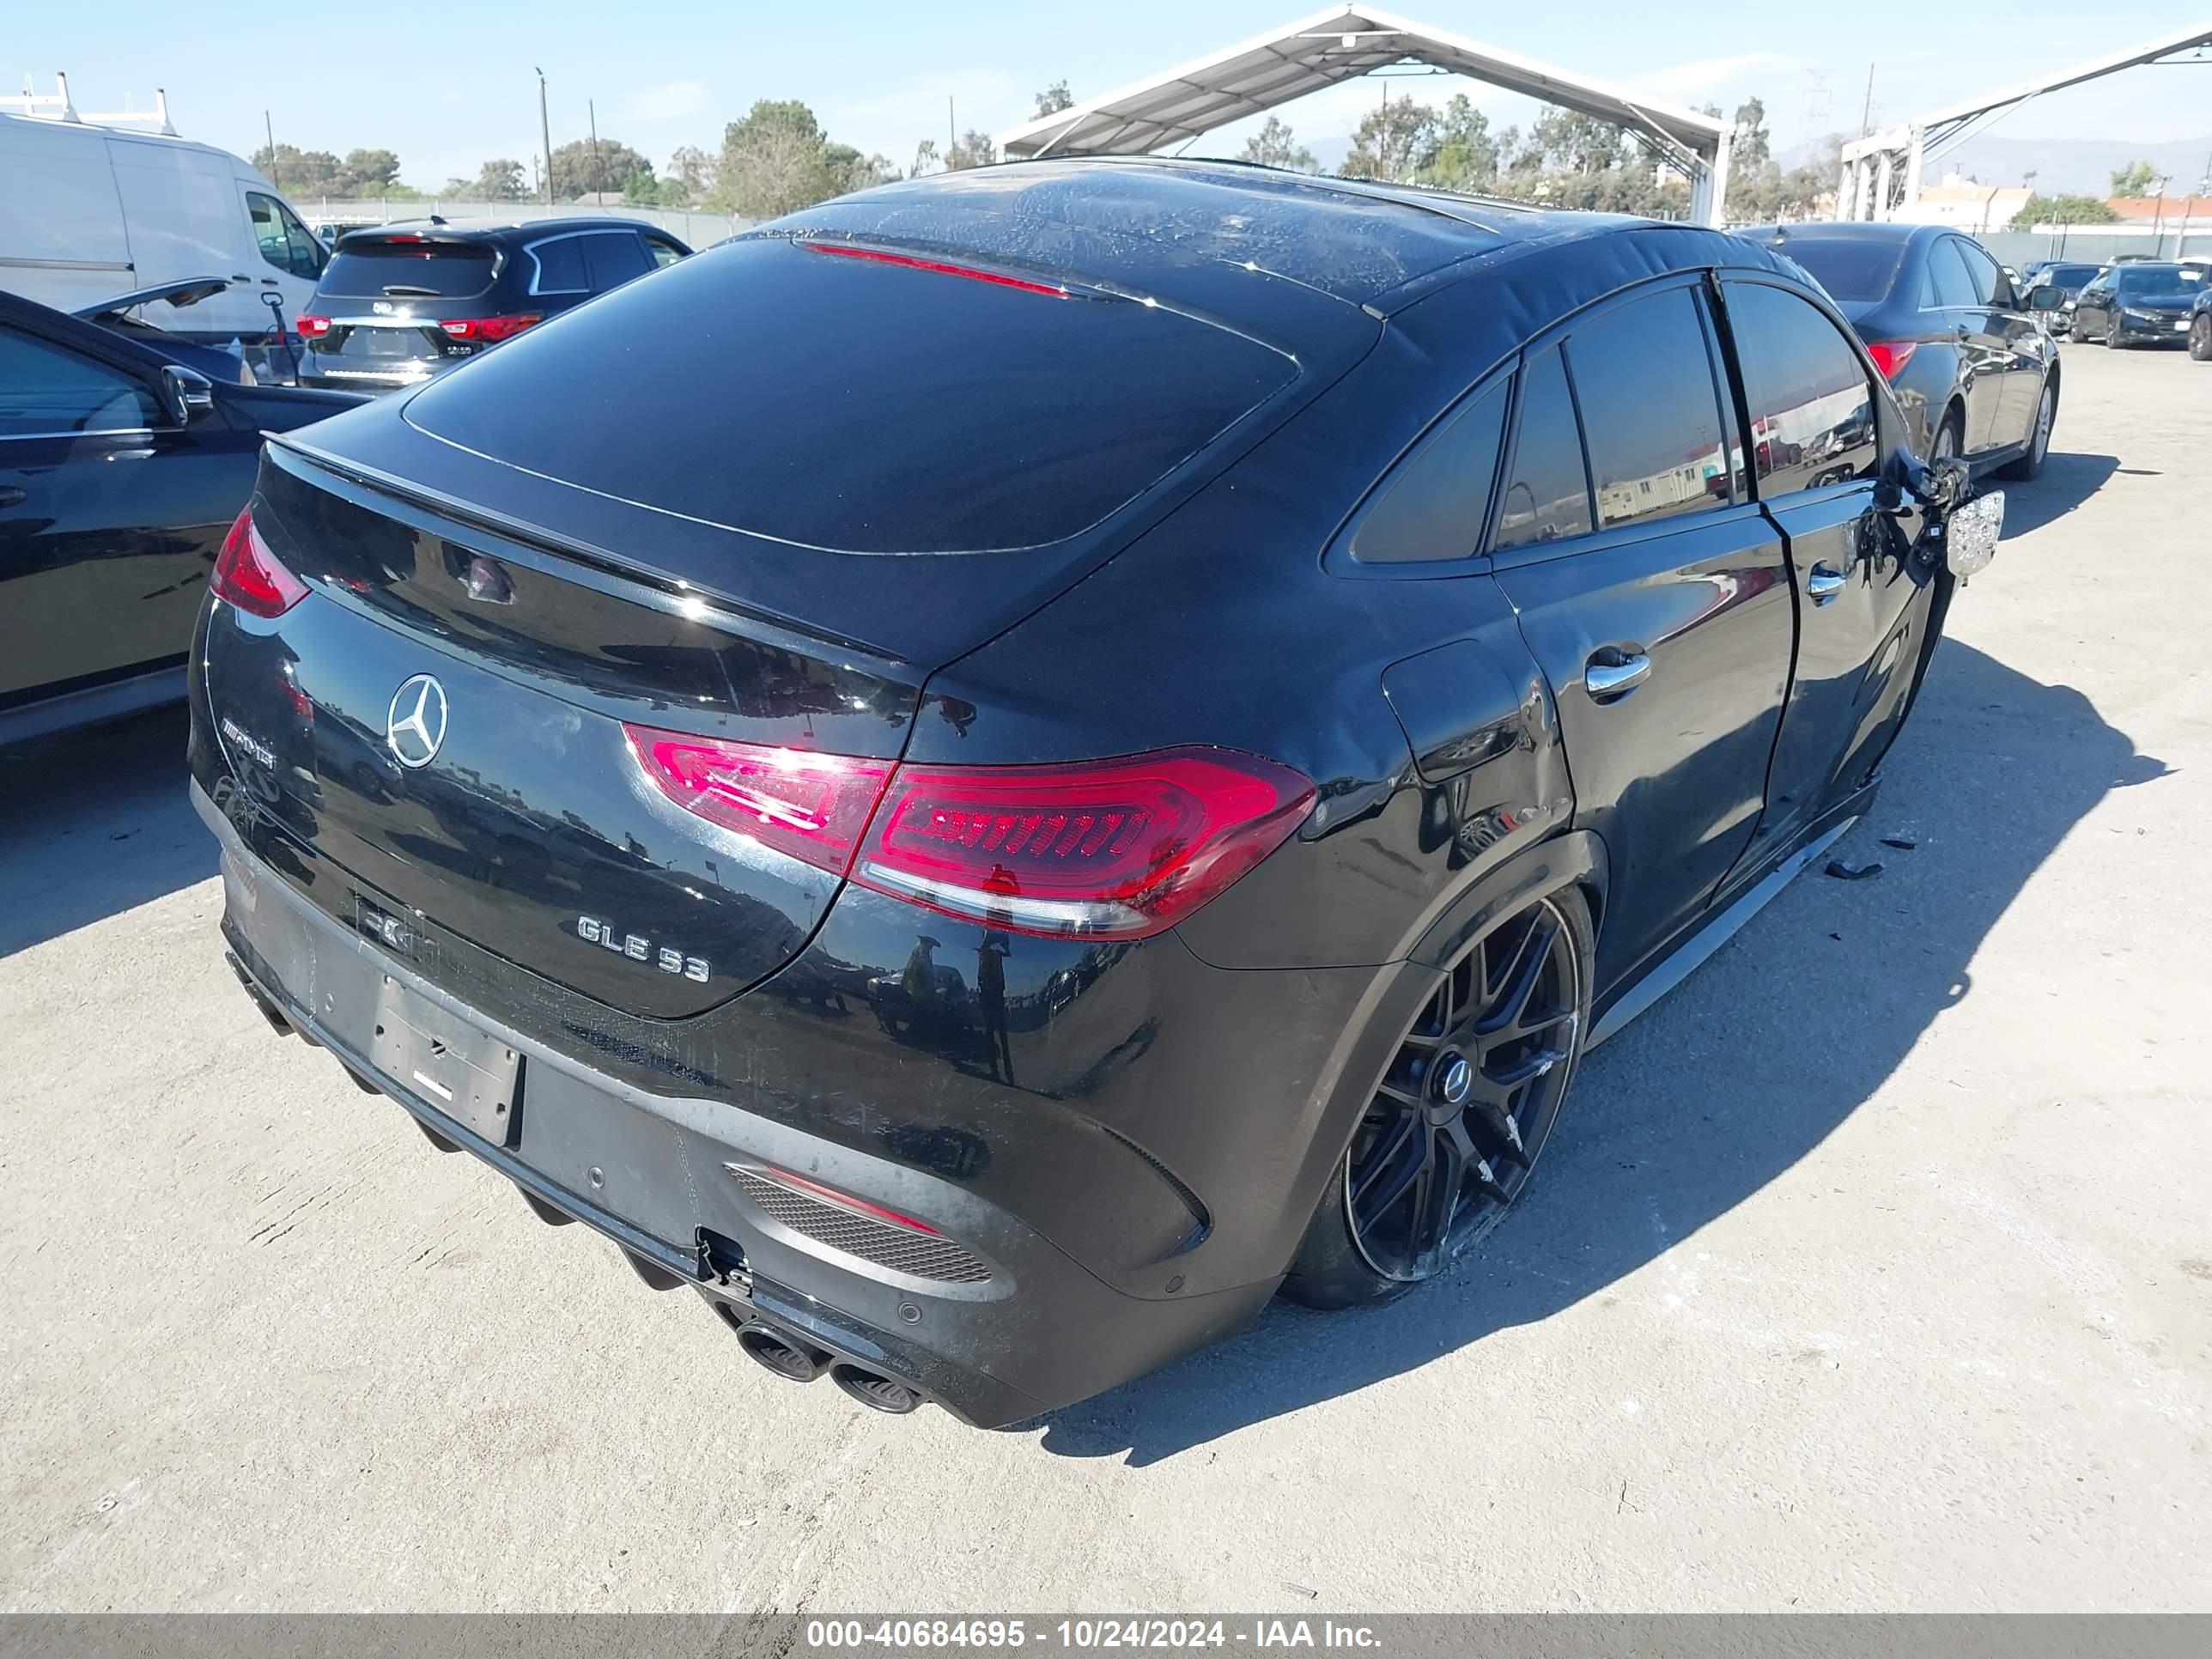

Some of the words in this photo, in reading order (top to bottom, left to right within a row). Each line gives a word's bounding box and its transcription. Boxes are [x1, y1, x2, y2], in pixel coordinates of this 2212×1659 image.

[234, 729, 276, 770] AMG
[578, 916, 650, 961] GLE
[658, 946, 711, 983] 53
